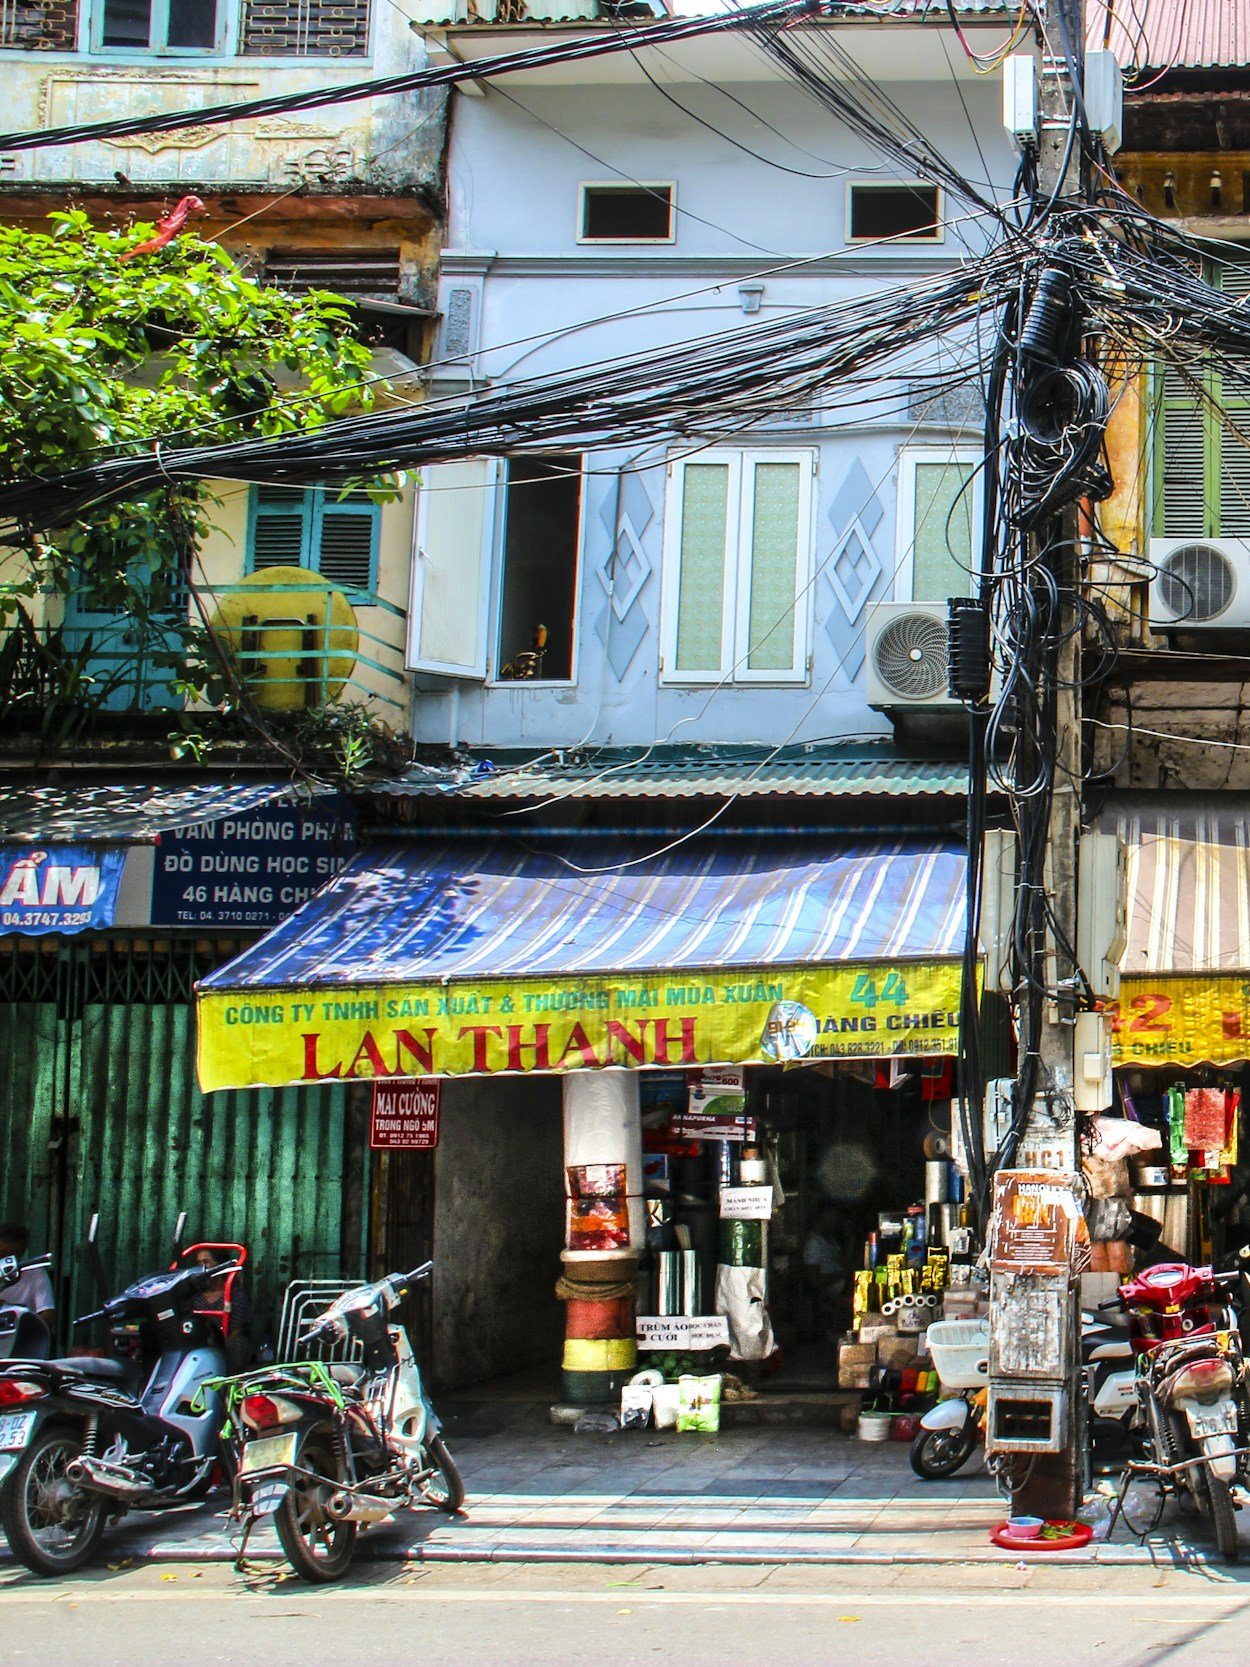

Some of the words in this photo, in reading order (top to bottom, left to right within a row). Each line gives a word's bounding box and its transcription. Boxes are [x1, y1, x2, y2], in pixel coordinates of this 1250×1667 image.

[223, 816, 294, 840] PHÒNG
[164, 847, 193, 872] ĐỒ
[200, 850, 260, 873] DÙNG
[267, 856, 309, 878] HỌC
[182, 885, 207, 902] 46
[214, 882, 273, 903] HÀNG
[280, 887, 316, 903] CH
[177, 910, 197, 921] TEL:
[218, 911, 242, 920] 3710
[245, 912, 269, 921] 0271
[225, 1002, 285, 1025] CÔNG
[292, 1003, 315, 1023] TY
[323, 1001, 379, 1021] TNHH
[386, 992, 429, 1019] SẢN
[436, 988, 493, 1016] XUẤT
[498, 995, 516, 1015] &
[523, 987, 609, 1012] THƯƠNG
[617, 989, 659, 1012] MẠI
[666, 980, 716, 1006] MÙA
[723, 980, 783, 1004] XUÂN
[850, 972, 910, 1009] 44
[816, 1014, 877, 1034] ÀNG
[886, 1007, 960, 1031] CHIẾU
[301, 1026, 438, 1080] LAN
[457, 1016, 698, 1073] THANH
[722, 1078, 739, 1086] 600
[376, 1092, 397, 1115] MAI
[398, 1086, 435, 1116] CƯỜNG
[375, 1119, 401, 1131] TRONG
